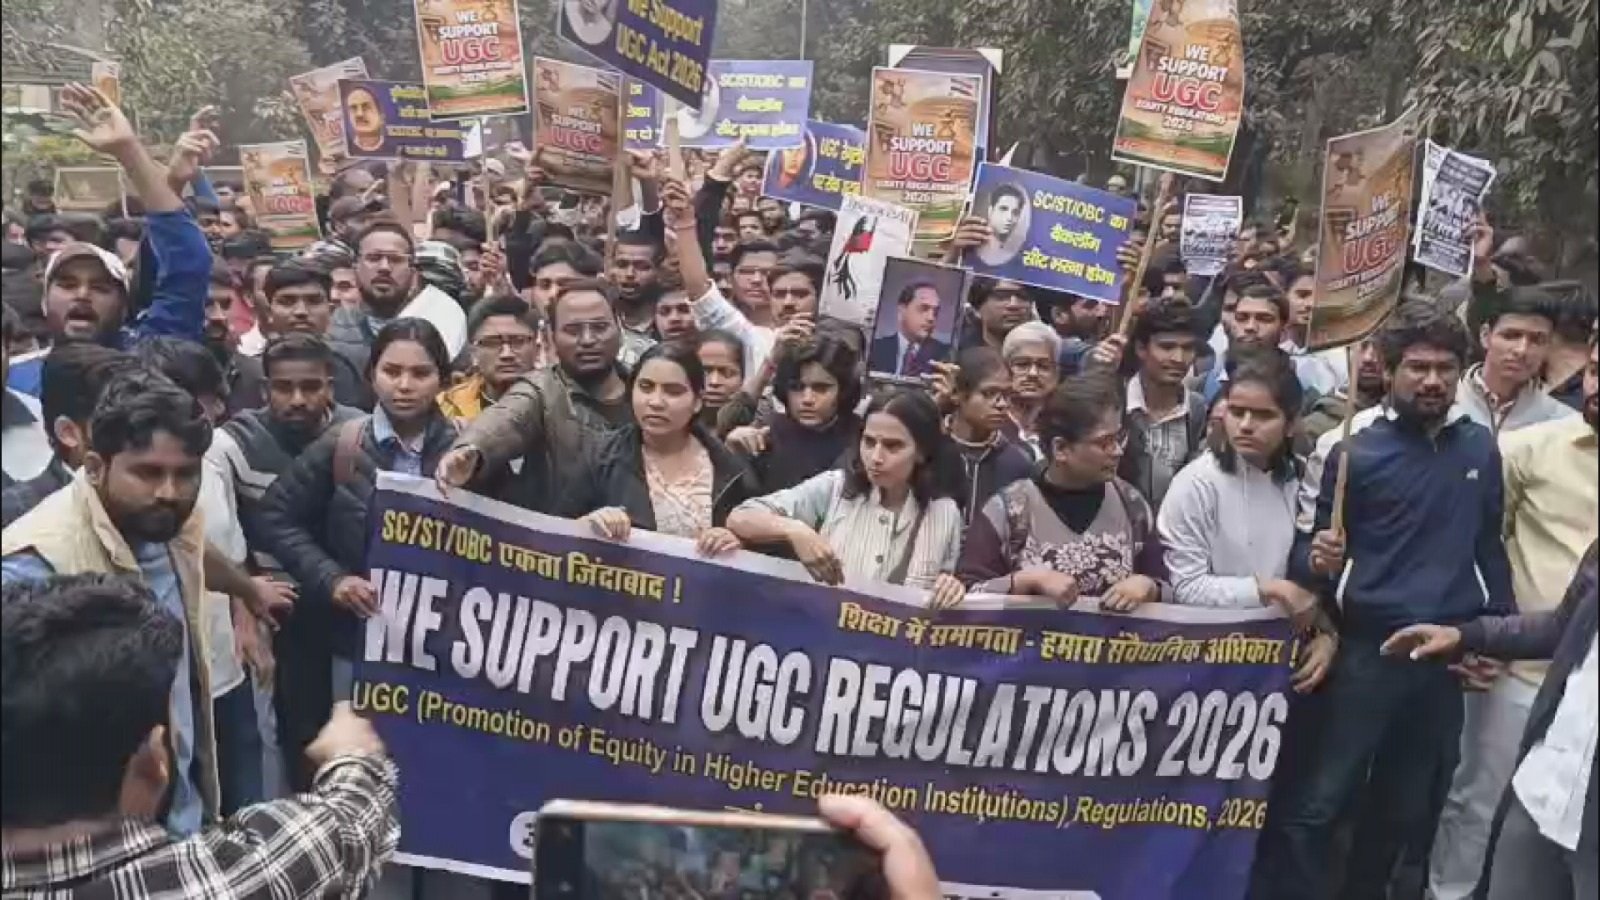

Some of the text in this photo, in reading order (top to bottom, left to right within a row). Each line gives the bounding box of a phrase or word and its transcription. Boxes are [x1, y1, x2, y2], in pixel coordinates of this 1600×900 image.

[439, 22, 499, 38] SUPPORT
[456, 10, 478, 22] WE
[649, 0, 704, 46] Support
[441, 36, 500, 65] UGC
[616, 22, 703, 93] UGC Act 2026
[1184, 44, 1210, 61] WE
[1157, 55, 1228, 82] SUPPORT
[1151, 71, 1223, 113] UGC
[551, 114, 602, 134] SUPPORT
[912, 122, 936, 137] WE
[1162, 115, 1194, 131] 2026
[551, 126, 603, 155] UGC
[890, 136, 954, 155] SUPPORT
[889, 151, 952, 182] UGC
[1032, 189, 1106, 223] SC/ST/OBC
[382, 509, 492, 563] SC/ST/OBC
[499, 541, 564, 580] एकता
[567, 551, 665, 601] जिंदाबाद
[838, 602, 902, 638] शिक्षा
[905, 616, 928, 645] में
[929, 625, 1023, 655] समानता
[1040, 629, 1105, 663] हमारा
[1107, 631, 1201, 663] संवैधानिक
[1204, 631, 1285, 664] अधिकार
[363, 567, 1288, 780] WE SUPPORT UGC REGULATIONS 2026
[353, 681, 409, 714] UGC
[416, 690, 550, 744] (Promotion
[558, 724, 585, 751] of
[589, 727, 667, 774] Equity
[672, 745, 696, 774] in
[703, 751, 789, 793] Higher
[791, 769, 918, 810] Education
[1072, 794, 1212, 832] Regulations,
[1217, 797, 1268, 830] 2026
